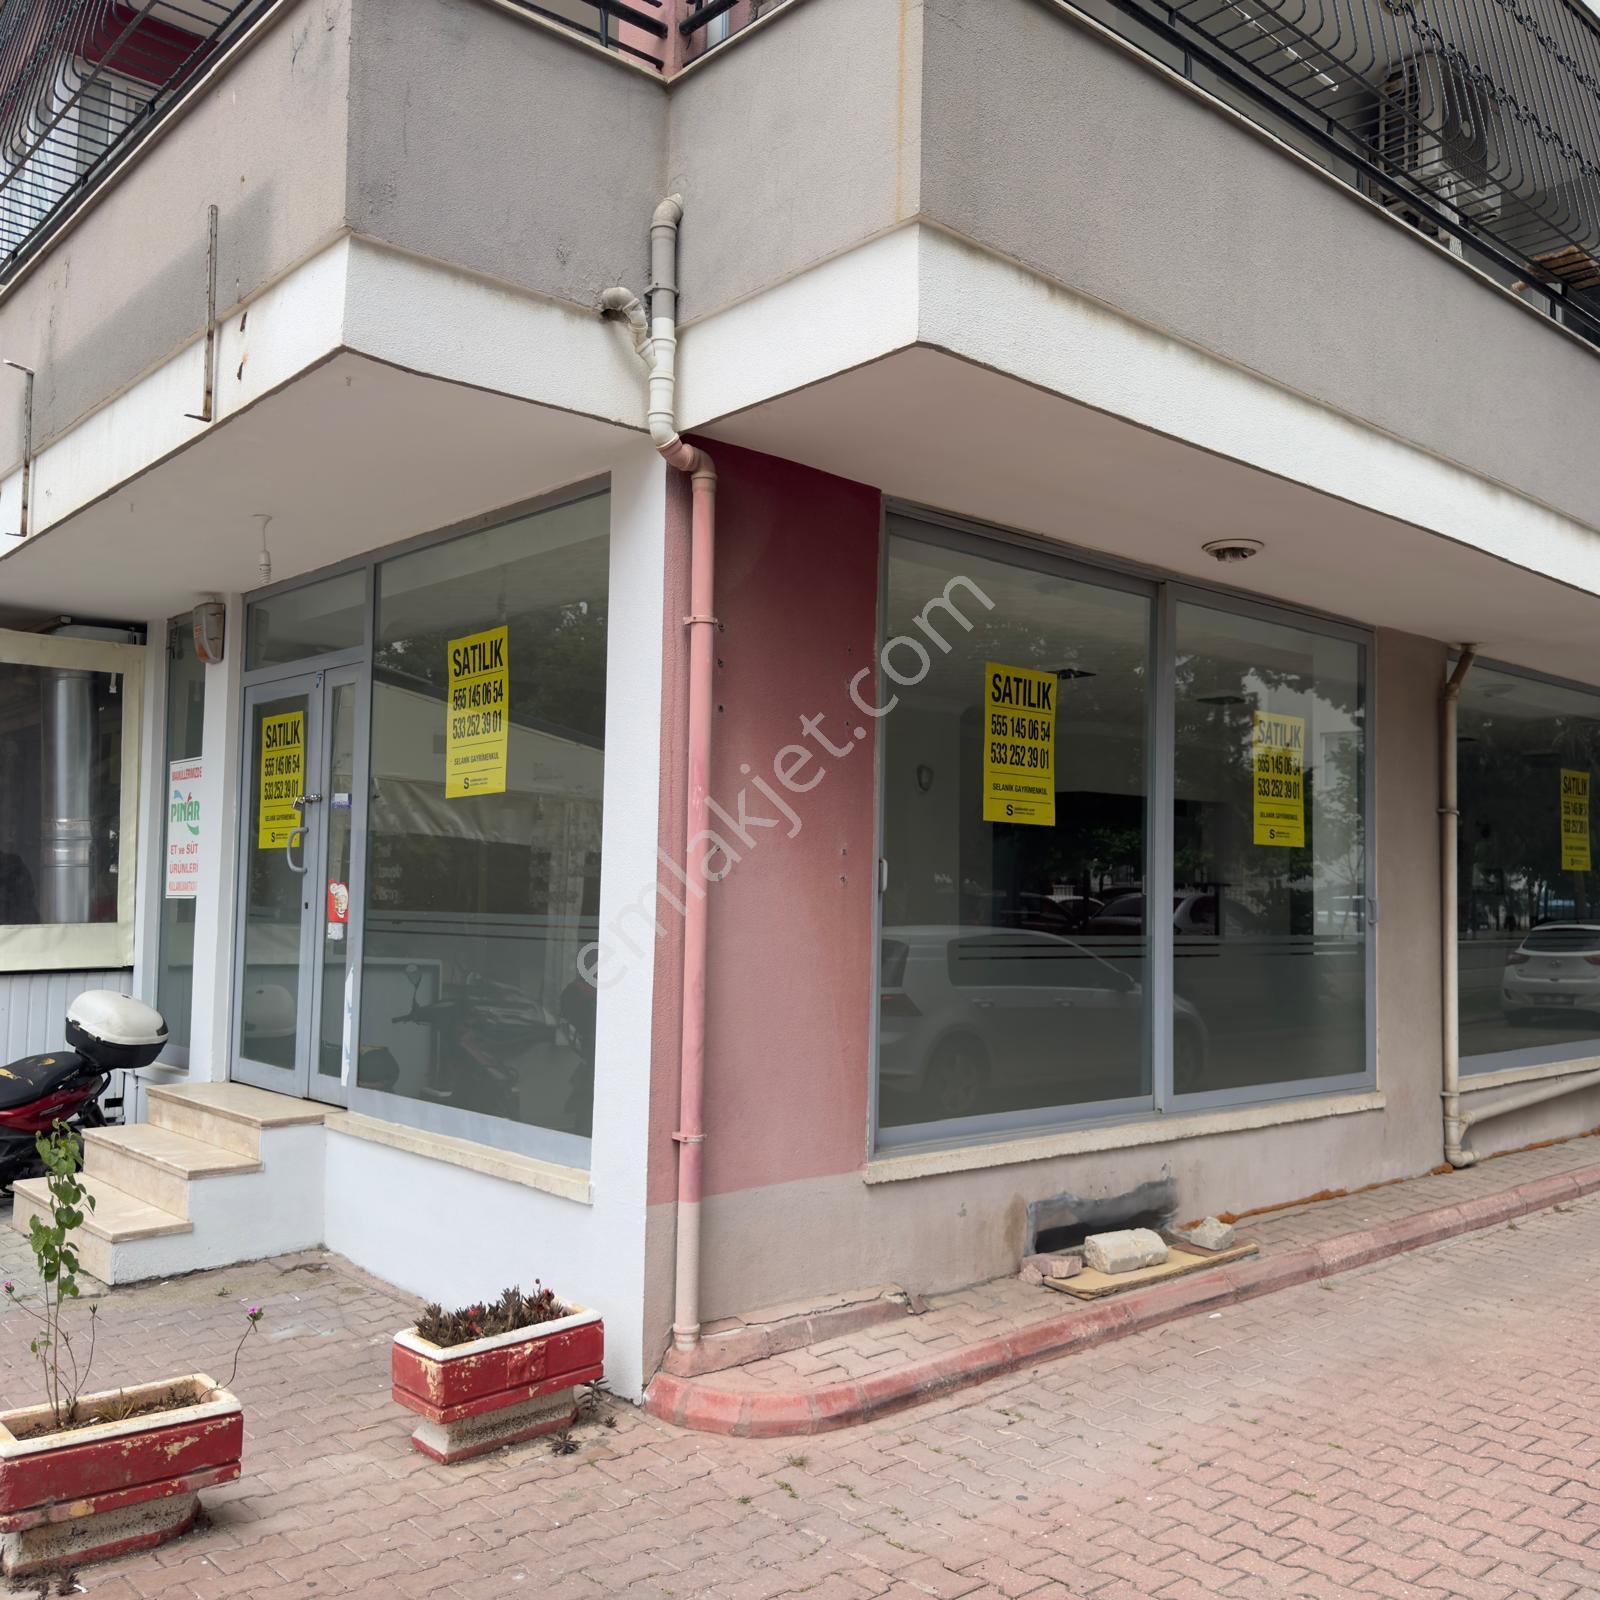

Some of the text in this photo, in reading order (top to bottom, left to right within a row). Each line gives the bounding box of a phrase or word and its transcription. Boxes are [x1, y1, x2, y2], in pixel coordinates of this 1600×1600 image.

[453, 638, 504, 678] SATILIK
[453, 679, 504, 711] 555 145 06 54
[991, 673, 1052, 711] SATILIK
[265, 719, 301, 749] SATILIK
[452, 709, 502, 740] 533 252 39 01
[991, 713, 1051, 742] 555 145 06 54
[1257, 719, 1302, 749] SATILIK
[264, 754, 300, 777] 555 145 06 54
[990, 742, 1049, 769] 533 252 39 01
[1257, 753, 1270, 773] 555
[1271, 754, 1283, 774] 145
[1284, 756, 1292, 775] 06
[264, 779, 299, 800] 533 252 39 01
[463, 777, 470, 789] S
[1257, 777, 1300, 800] 533 252 39 01
[170, 800, 200, 823] PINAR
[1006, 804, 1014, 816] S
[271, 832, 276, 842] S
[1269, 829, 1275, 839] S
[170, 840, 199, 855] ET ve SÜT
